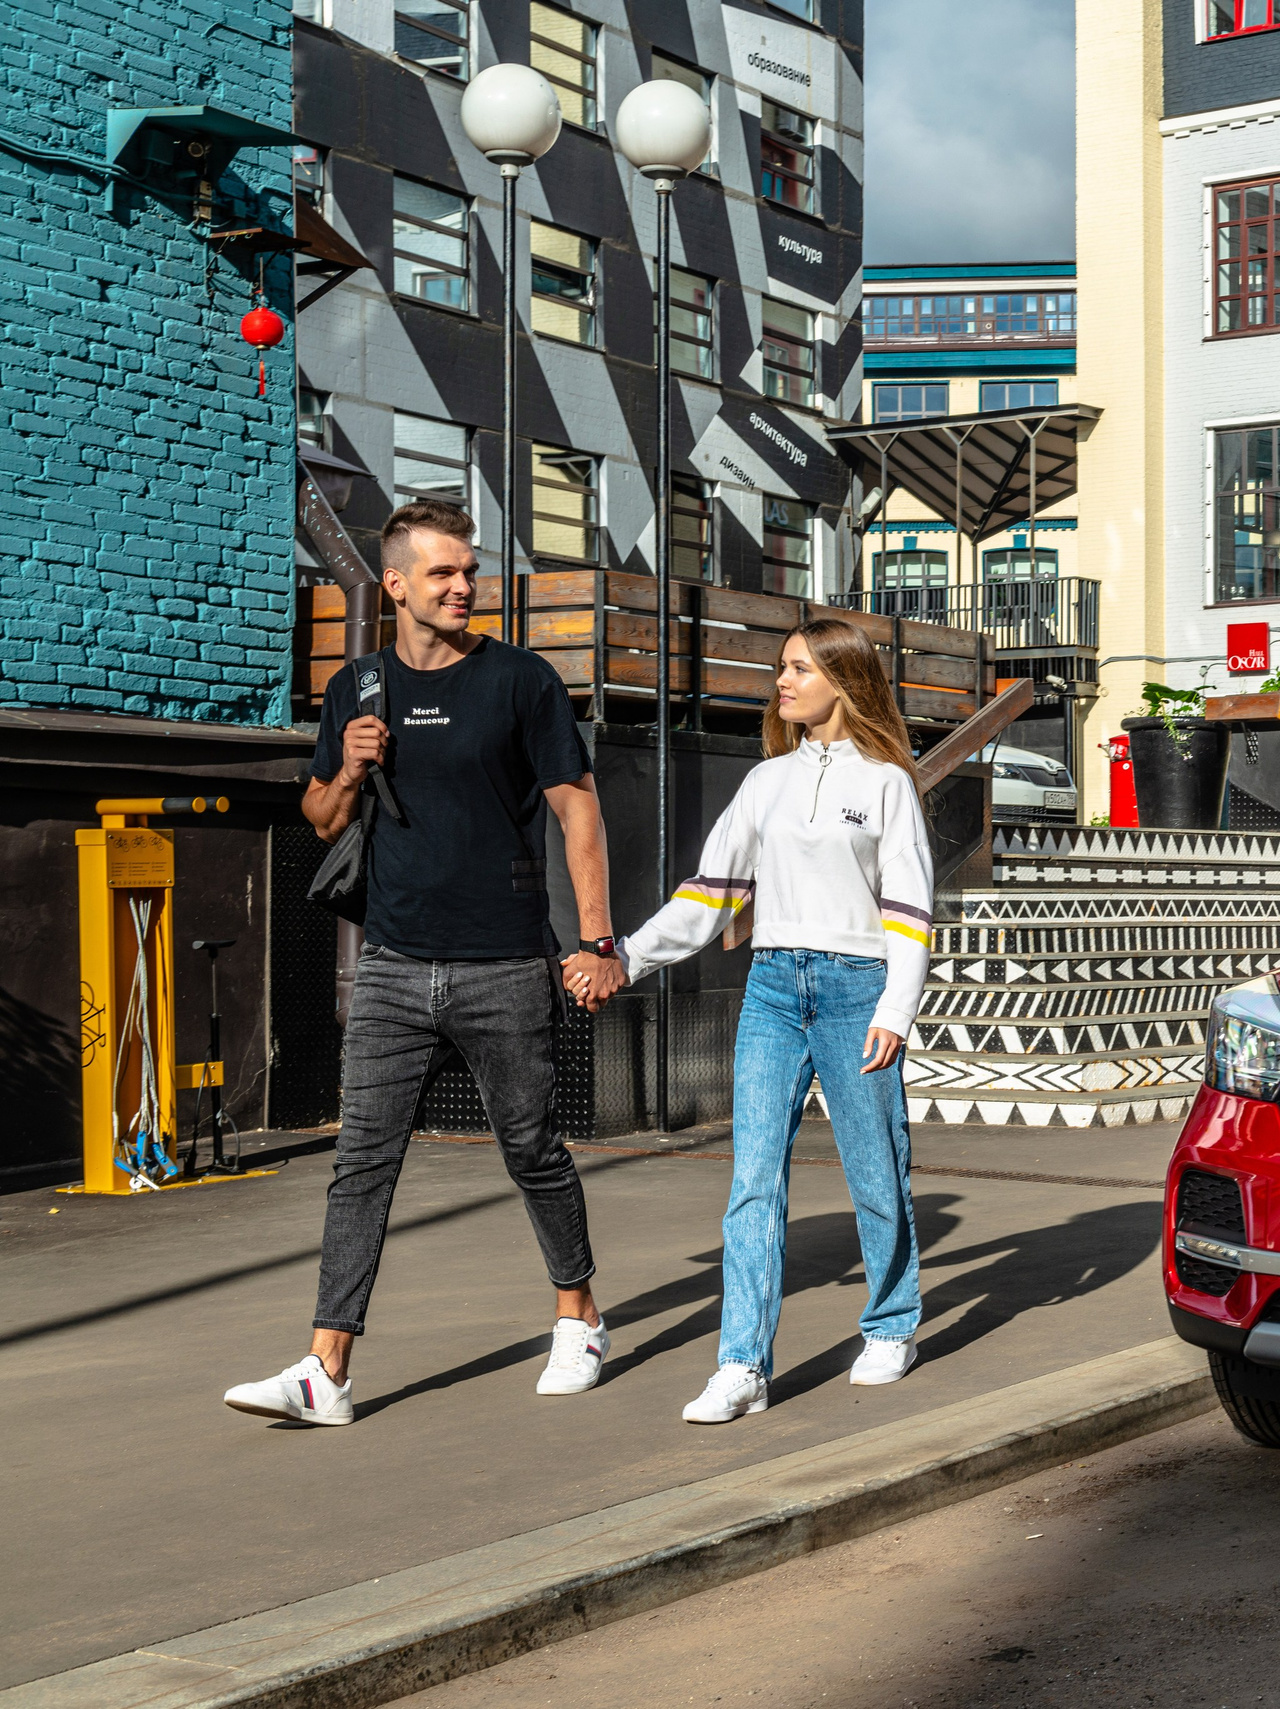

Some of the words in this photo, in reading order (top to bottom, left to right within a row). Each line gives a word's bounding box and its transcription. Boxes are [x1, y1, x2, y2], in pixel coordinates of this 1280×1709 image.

[748, 52, 811, 88] образование
[778, 234, 823, 264] культура
[749, 412, 808, 468] архитектура
[403, 717, 450, 725] Beaucoup
[412, 707, 440, 716] Merci
[841, 808, 869, 821] RELAX
